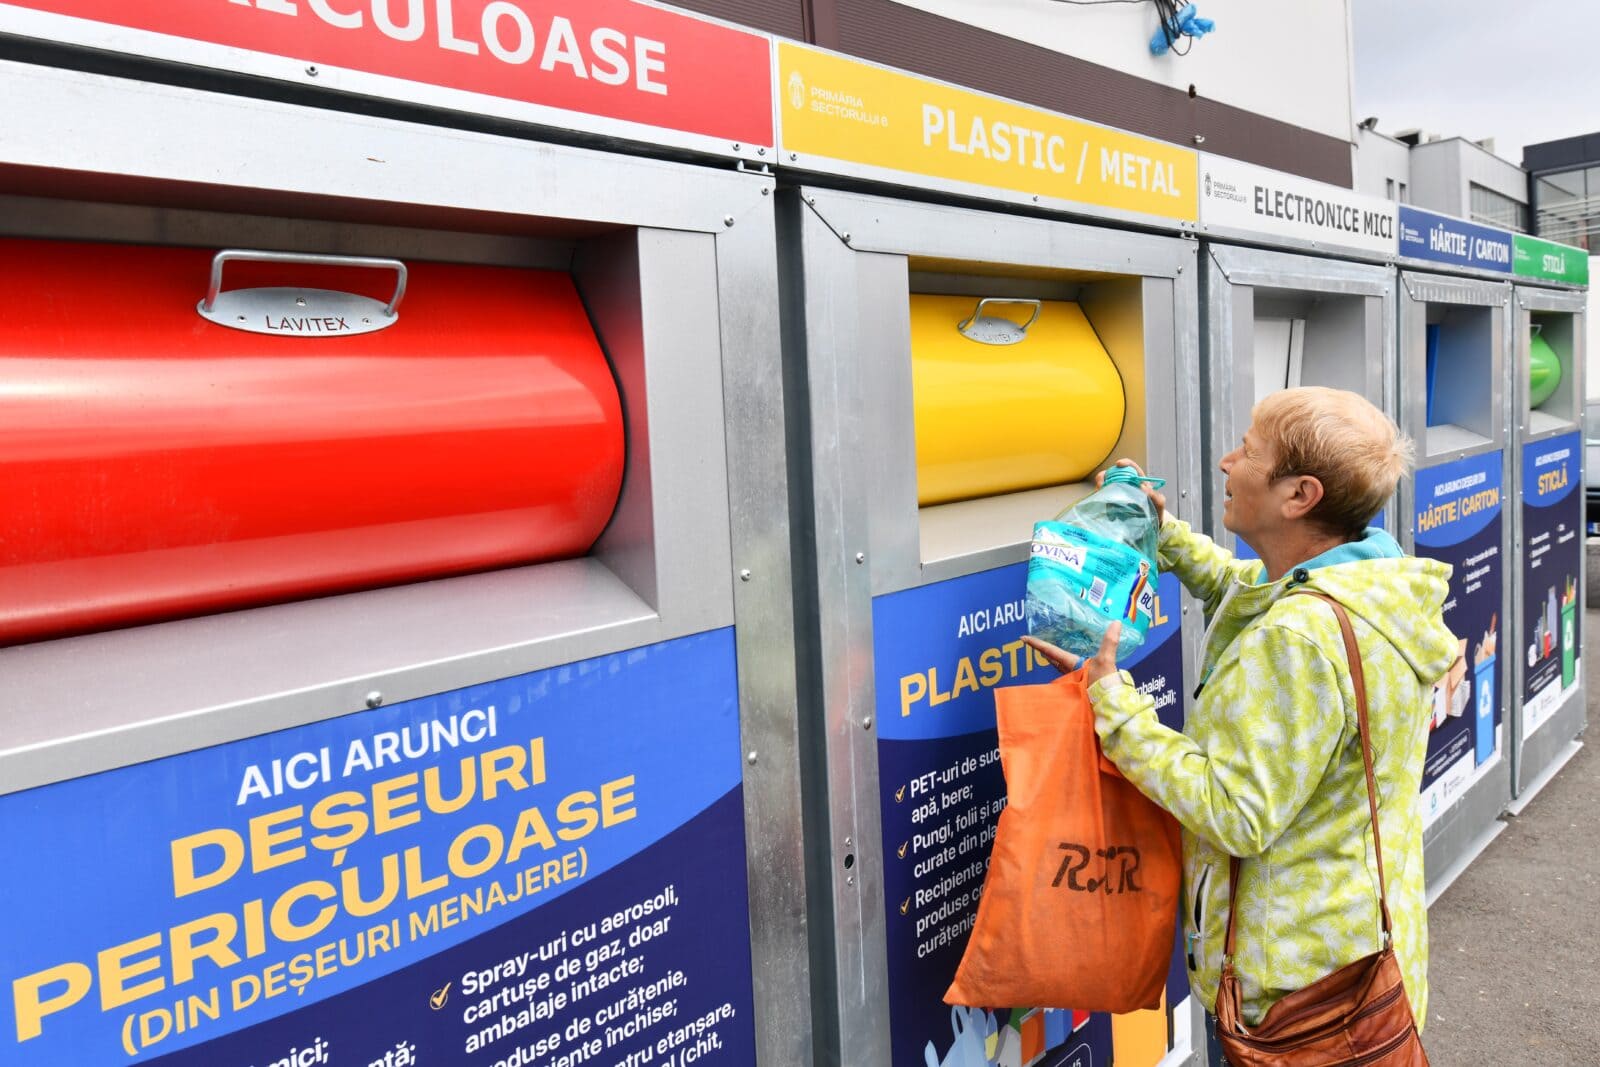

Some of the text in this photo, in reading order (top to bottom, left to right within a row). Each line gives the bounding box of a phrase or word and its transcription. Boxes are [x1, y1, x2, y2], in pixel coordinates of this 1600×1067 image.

[228, 0, 668, 95] CULOASE
[922, 103, 1181, 198] PLASTIC / METAL
[1254, 186, 1359, 232] ELECTRONICE
[1363, 213, 1393, 239] MICI
[1430, 223, 1467, 256] HÂRTIE
[1475, 238, 1509, 264] CARTON
[265, 315, 350, 332] LAVITEX
[1461, 487, 1499, 517] CARTON
[958, 599, 1025, 638] AICI ARU
[236, 705, 497, 806] AICI ARUNCI
[910, 761, 959, 798] PET-uri
[961, 757, 977, 775] de
[170, 736, 546, 898] DEȘEURI
[911, 784, 973, 824] apă, bere;
[913, 819, 954, 854] Pungi,
[955, 806, 978, 833] folii
[980, 801, 990, 825] și
[913, 846, 956, 879] curate
[958, 833, 978, 855] din
[980, 824, 997, 849] pla
[12, 774, 637, 1043] PERICULOASE
[915, 861, 983, 909] Recipiente
[460, 884, 679, 995] Spray-uri cu aerosoli,
[916, 893, 969, 938] produse
[121, 846, 588, 1057] (DIN DEȘEURI MENAJERE)
[463, 914, 671, 1025] cartușe de gaz, doar
[464, 954, 645, 1055] ambalaje intacte;
[489, 969, 687, 1067] duse de curățenie,
[656, 1001, 735, 1054] etanșare,
[544, 999, 677, 1067] iente închise;
[680, 1031, 722, 1067] (chit,
